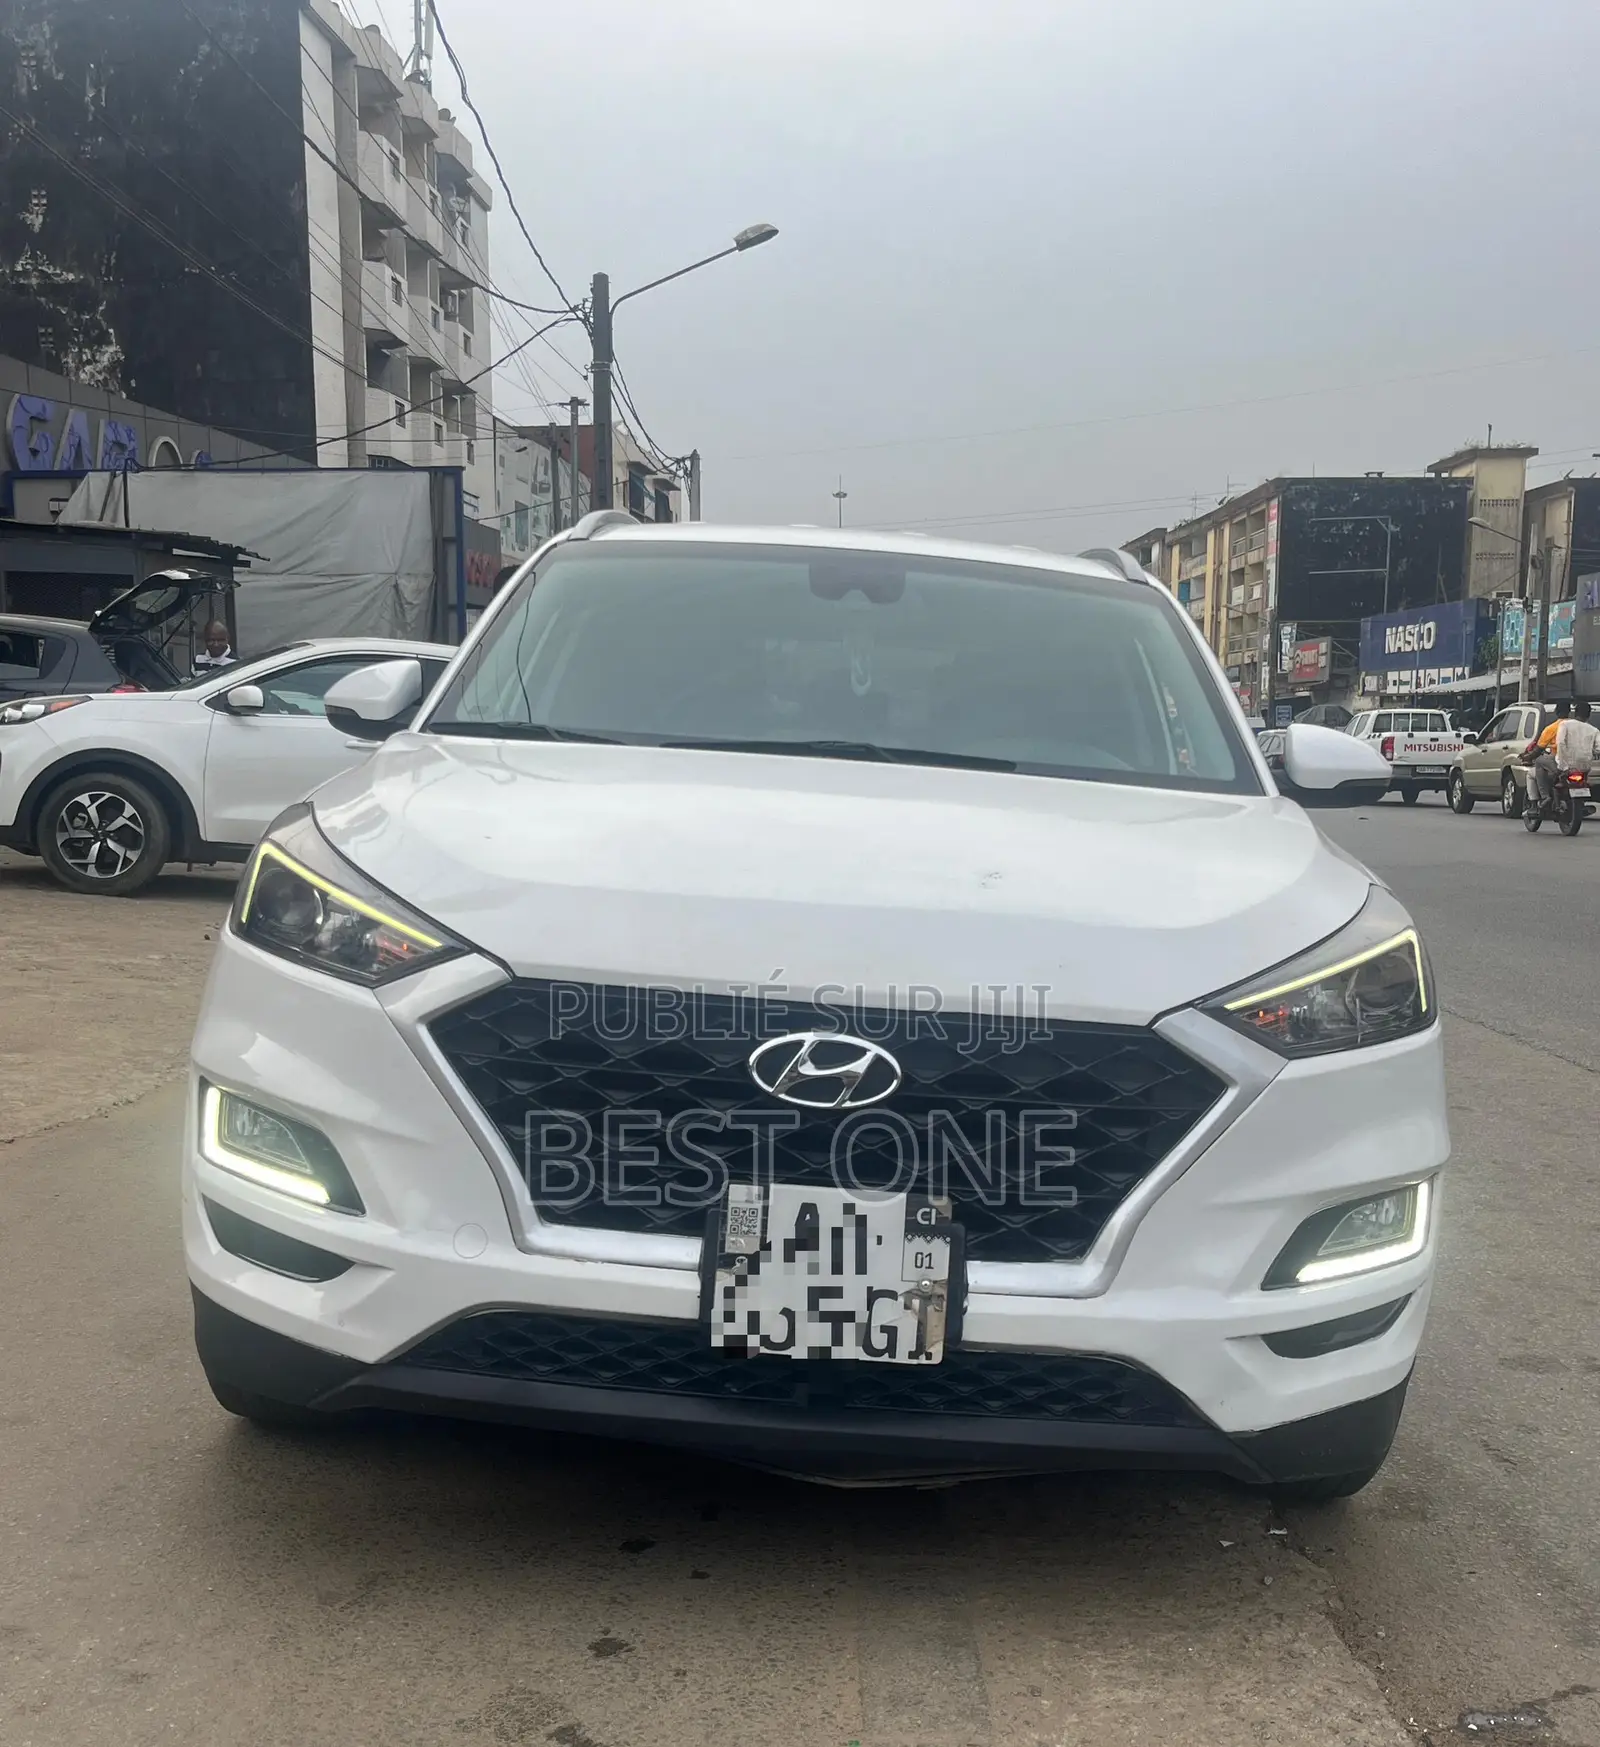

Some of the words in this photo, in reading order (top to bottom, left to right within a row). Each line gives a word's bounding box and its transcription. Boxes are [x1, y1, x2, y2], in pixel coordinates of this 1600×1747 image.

[1384, 621, 1437, 654] NASCO
[1404, 743, 1464, 752] MITSUBISHI
[916, 1207, 937, 1225] CI
[914, 1252, 934, 1269] 01
